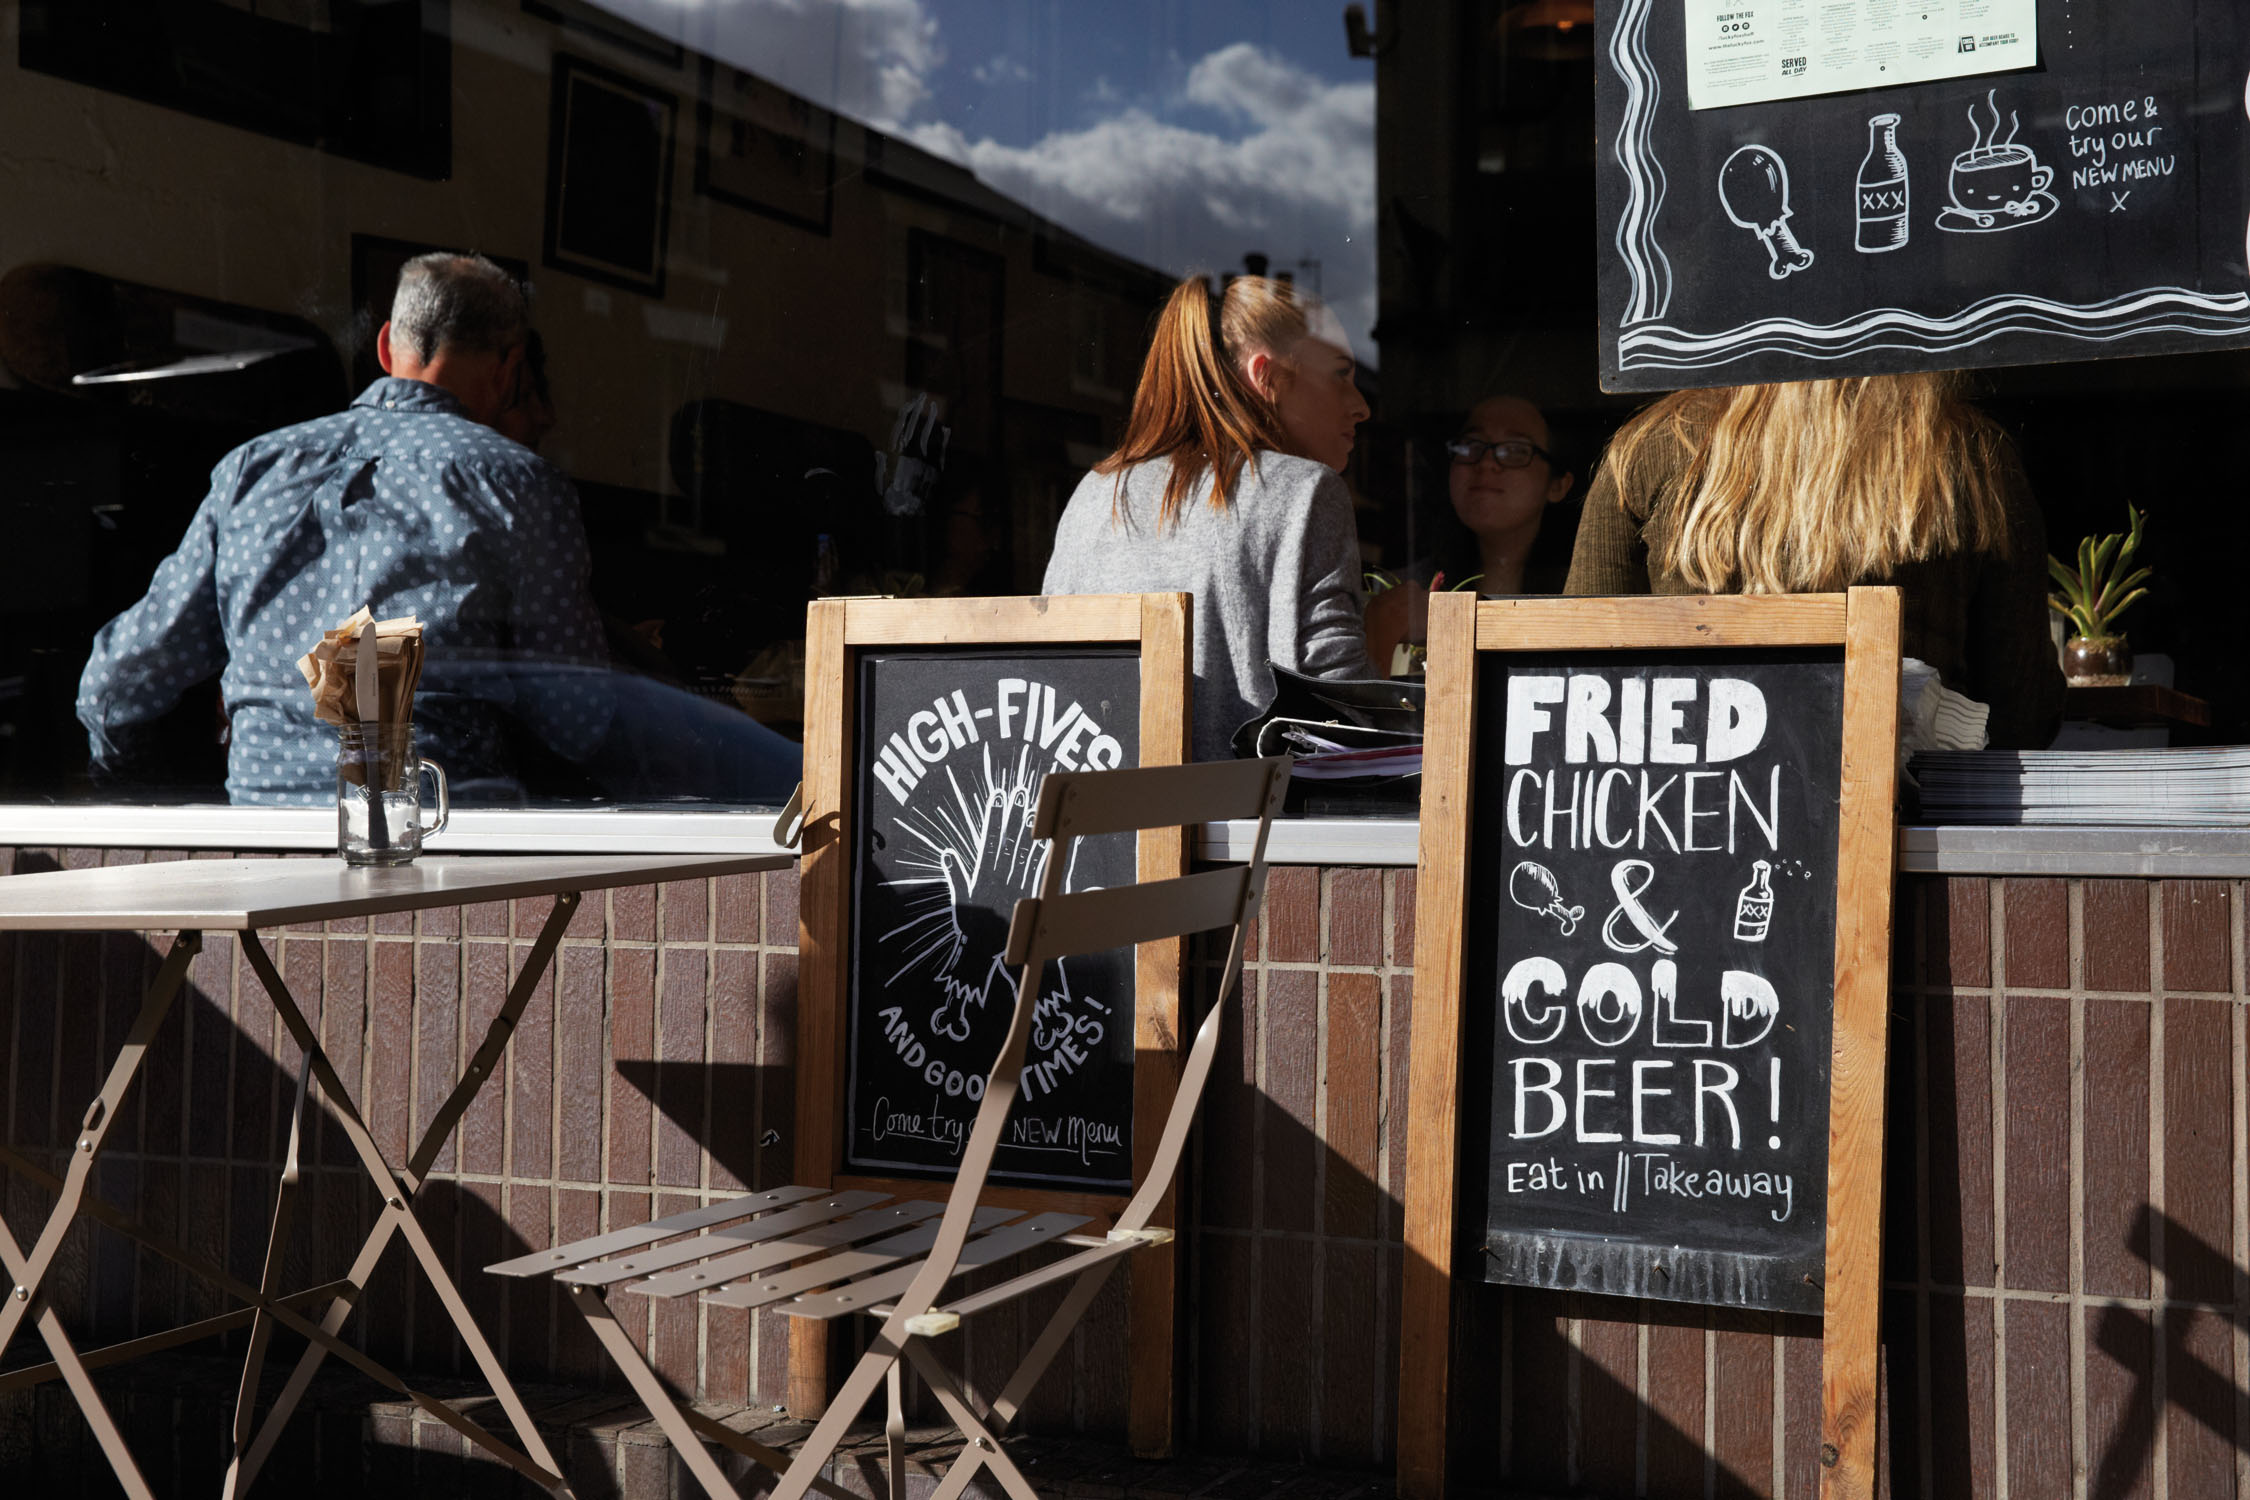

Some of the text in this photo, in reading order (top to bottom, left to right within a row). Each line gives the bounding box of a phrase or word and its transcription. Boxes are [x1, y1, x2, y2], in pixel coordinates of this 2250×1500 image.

[1716, 14, 1734, 22] FOLLOW
[1781, 56, 1807, 69] SERVED
[2144, 96, 2158, 118] &
[2069, 127, 2163, 167] try our
[2072, 155, 2175, 190] NEW MENU
[1505, 674, 1768, 766] FRIED
[1506, 764, 1780, 855] CHICKEN
[1602, 859, 1679, 955] &
[1502, 956, 1780, 1049] COLD
[878, 1006, 926, 1068] AND
[923, 1060, 991, 1101] GOO
[872, 1096, 925, 1142] Come
[927, 1093, 963, 1156] try
[1013, 1116, 1063, 1144] NEW
[1508, 1056, 1782, 1150] BEER!
[1507, 1157, 1567, 1193] Eat
[1574, 1162, 1605, 1194] in
[1633, 1152, 1793, 1223] Takeaway
